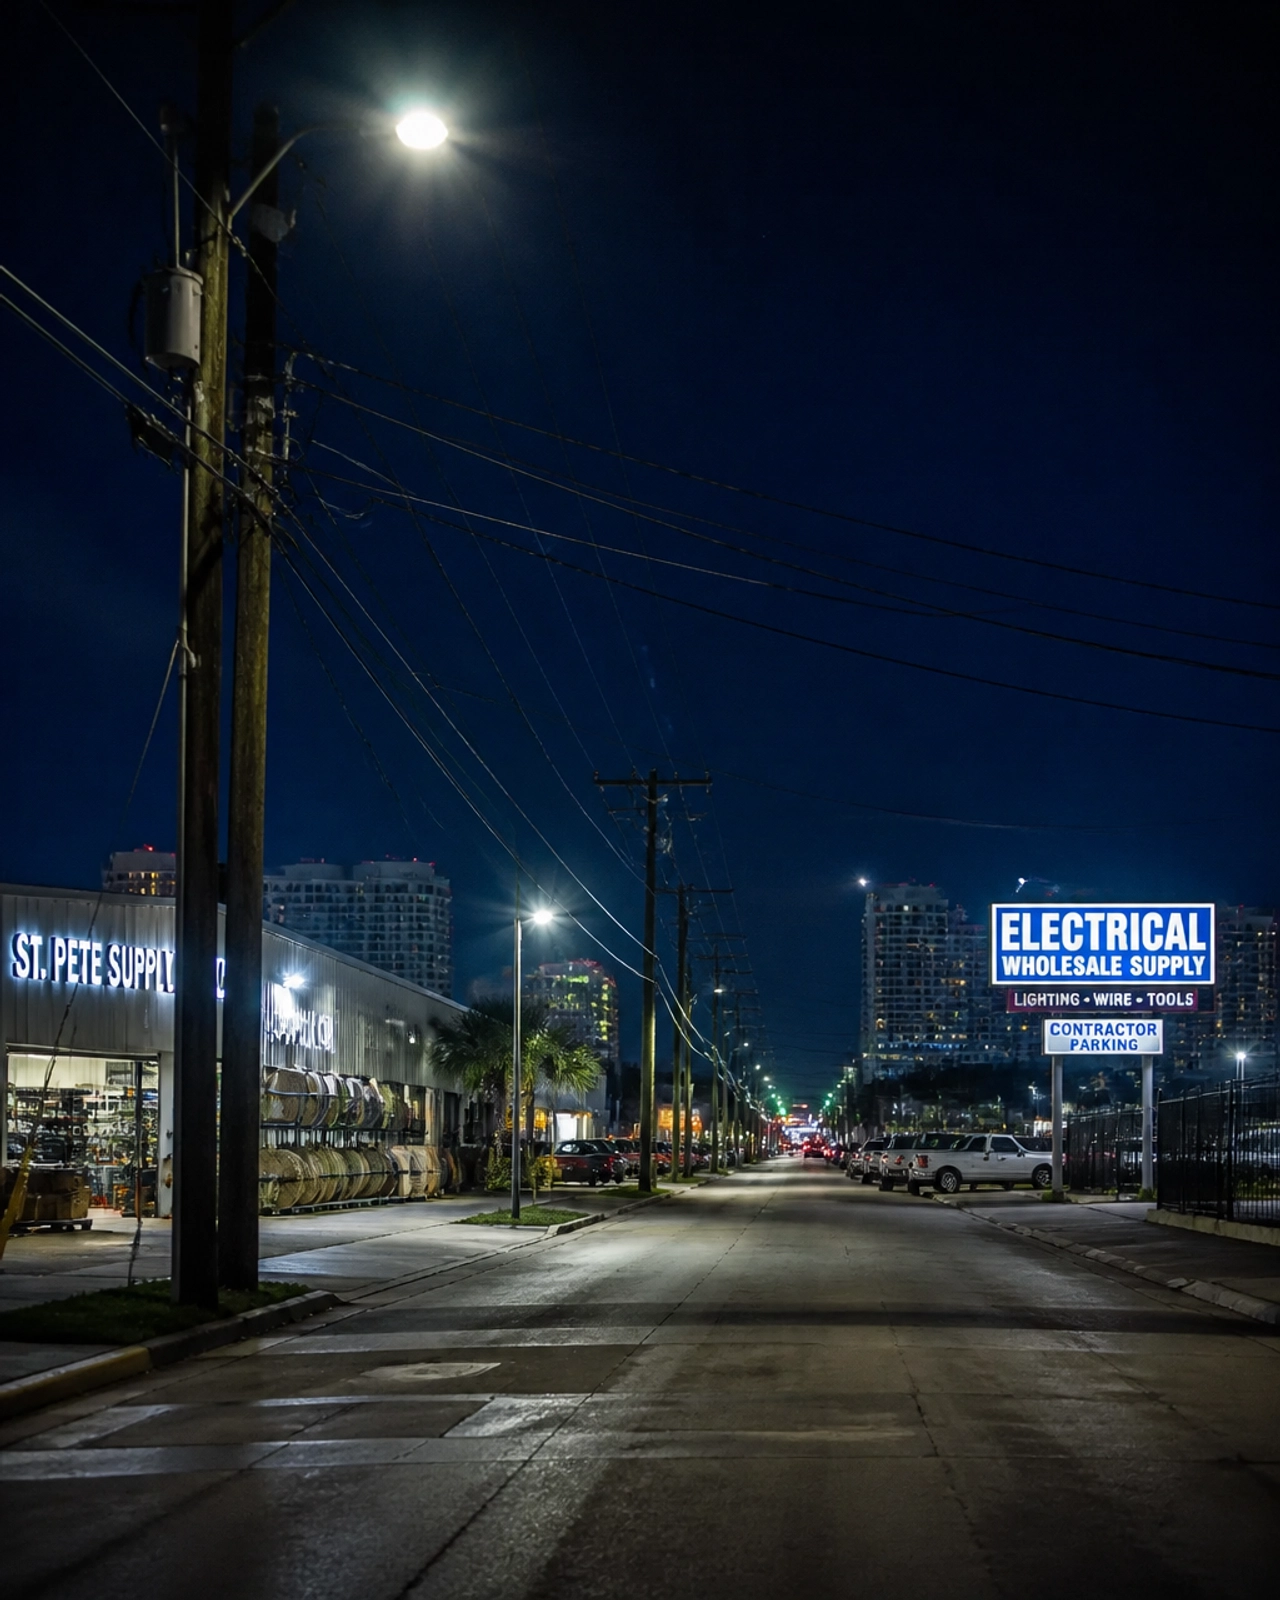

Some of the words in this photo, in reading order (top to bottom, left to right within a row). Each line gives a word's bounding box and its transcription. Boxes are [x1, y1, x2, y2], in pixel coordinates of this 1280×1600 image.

[1001, 912, 1207, 951] ELECTRICAL
[12, 933, 47, 981] ST.
[51, 937, 102, 985] PETE
[107, 944, 176, 993] SUPPLY
[1001, 956, 1123, 976] WHOLESALE
[1130, 956, 1206, 976] SUPPLY
[1014, 992, 1080, 1007] LIGHTING
[1093, 992, 1132, 1007] WIRE
[1147, 992, 1194, 1007] TOOLS
[1050, 1022, 1158, 1036] CONTRACTOR
[1070, 1038, 1138, 1051] PARKING
